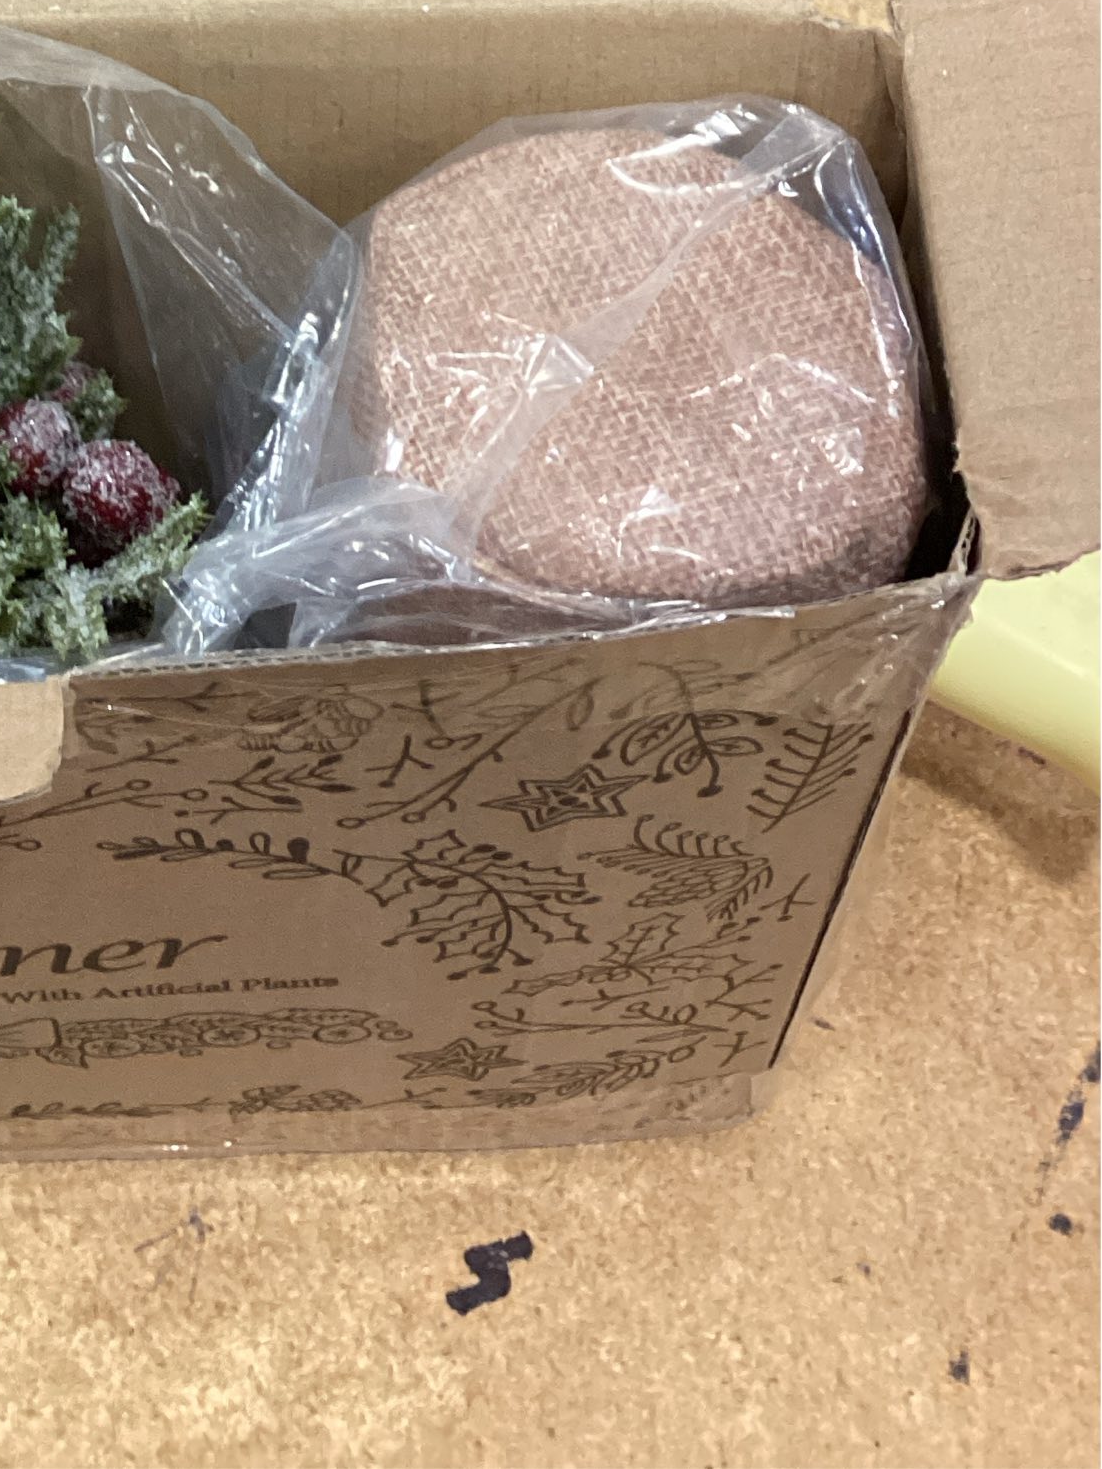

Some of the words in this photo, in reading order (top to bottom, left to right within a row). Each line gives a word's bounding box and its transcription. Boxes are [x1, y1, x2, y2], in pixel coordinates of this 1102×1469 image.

[0, 987, 83, 1004] With
[93, 979, 231, 999] Artificial
[241, 977, 339, 991] Plants
